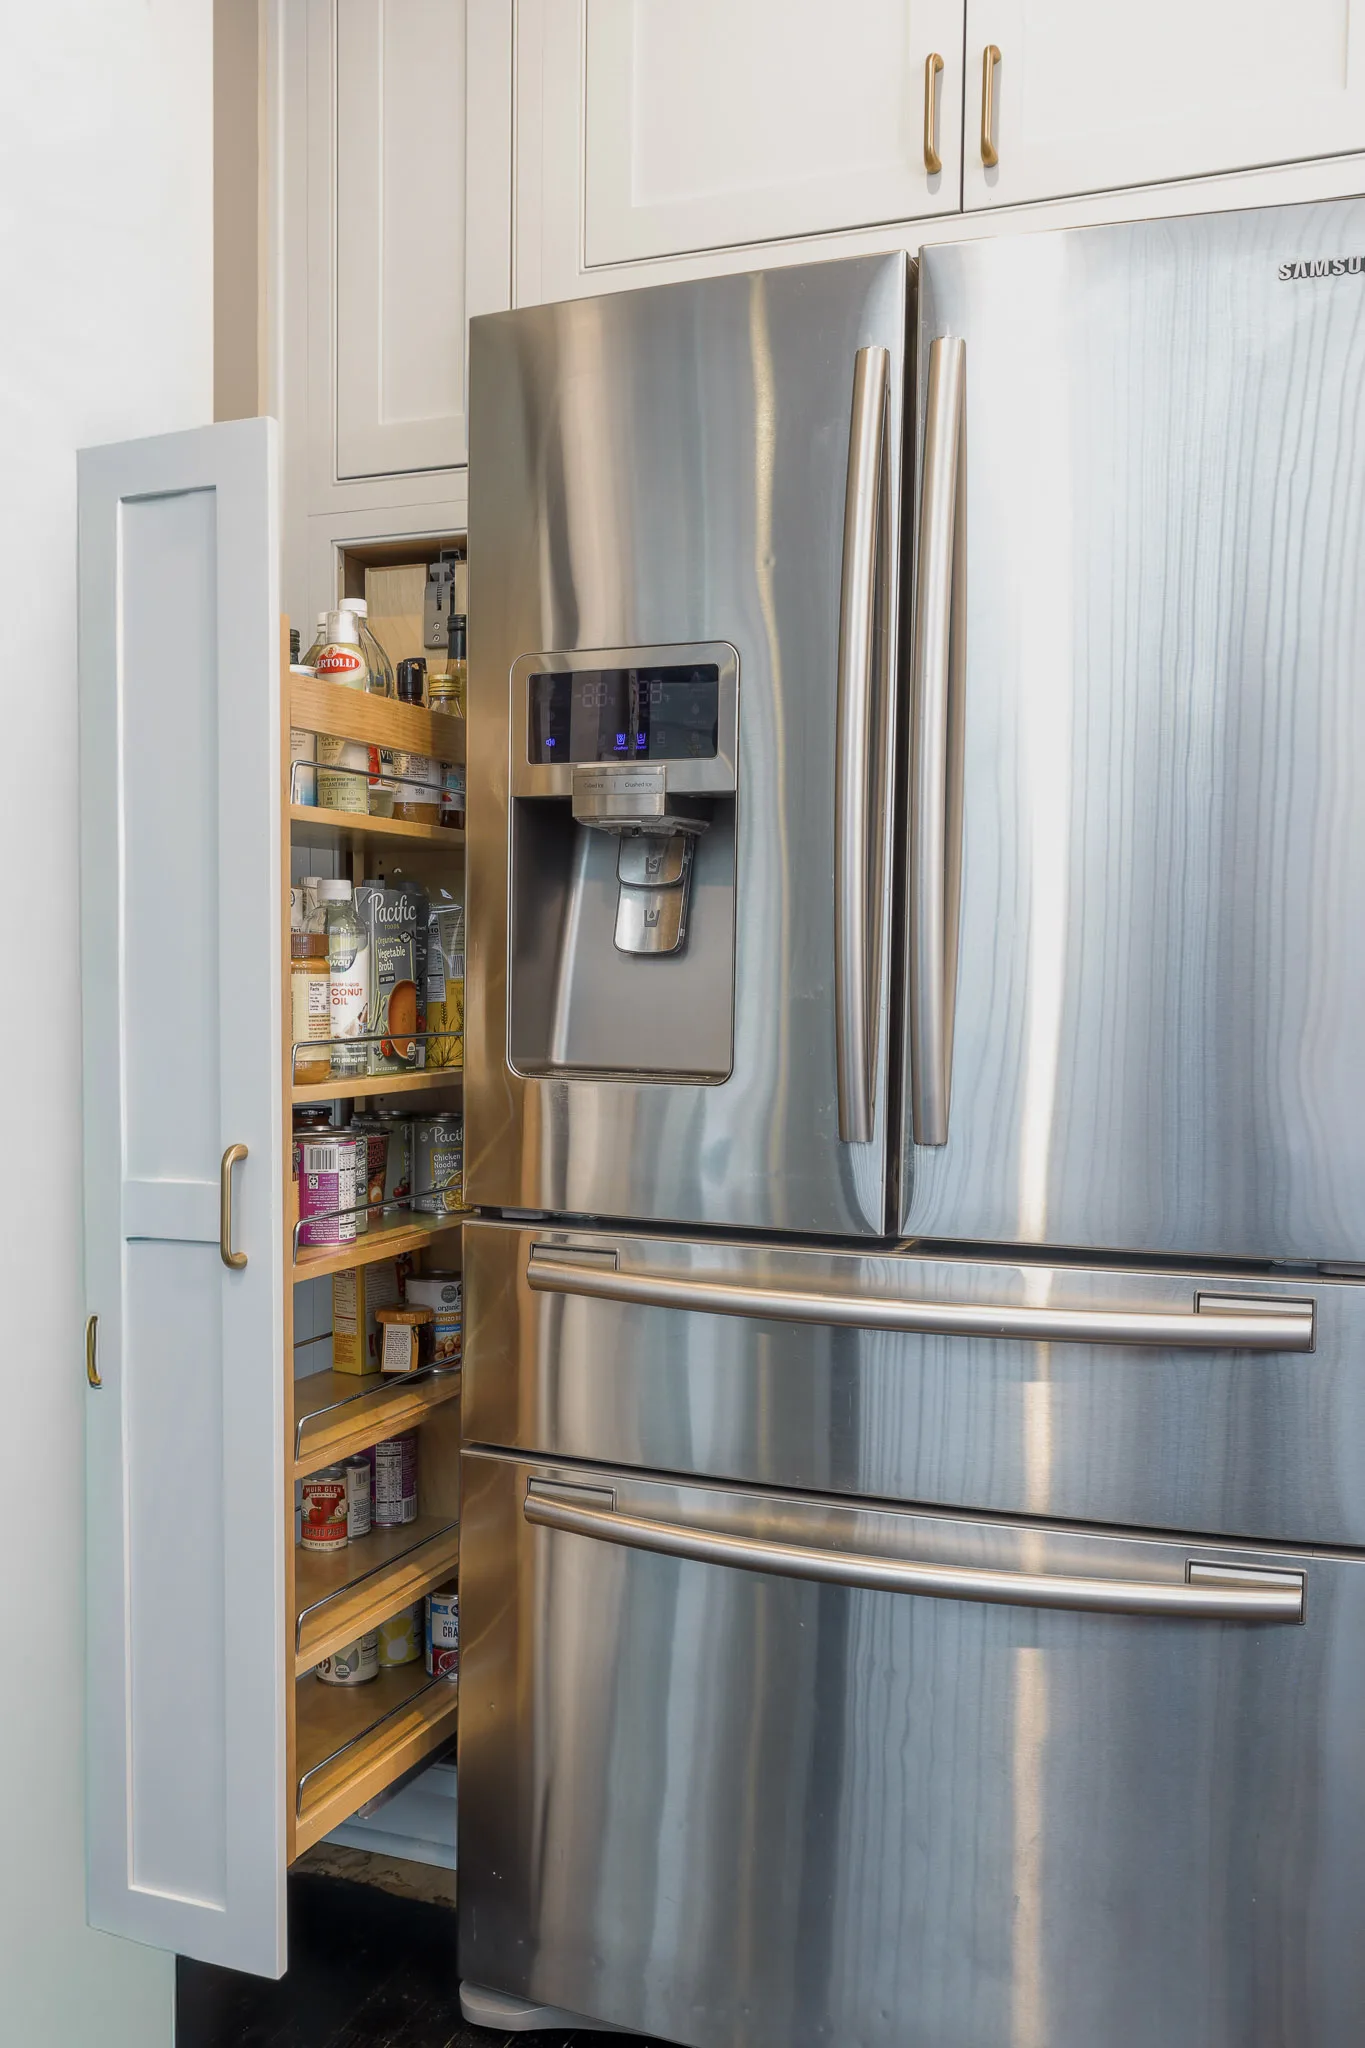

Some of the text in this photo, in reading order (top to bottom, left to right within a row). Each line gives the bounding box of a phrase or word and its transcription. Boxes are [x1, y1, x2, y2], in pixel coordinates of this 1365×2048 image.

[1278, 255, 1365, 281] SAMSU
[316, 657, 356, 668] ERTOLLI
[368, 892, 417, 924] Pacific
[377, 936, 394, 947] Organic
[378, 945, 406, 962] Vegetable
[378, 960, 394, 972] Broth
[332, 998, 348, 1006] OIL
[433, 1153, 461, 1161] Chicken
[437, 1303, 461, 1312] organic
[324, 1485, 342, 1493] GLEN
[442, 1626, 459, 1638] CRA
